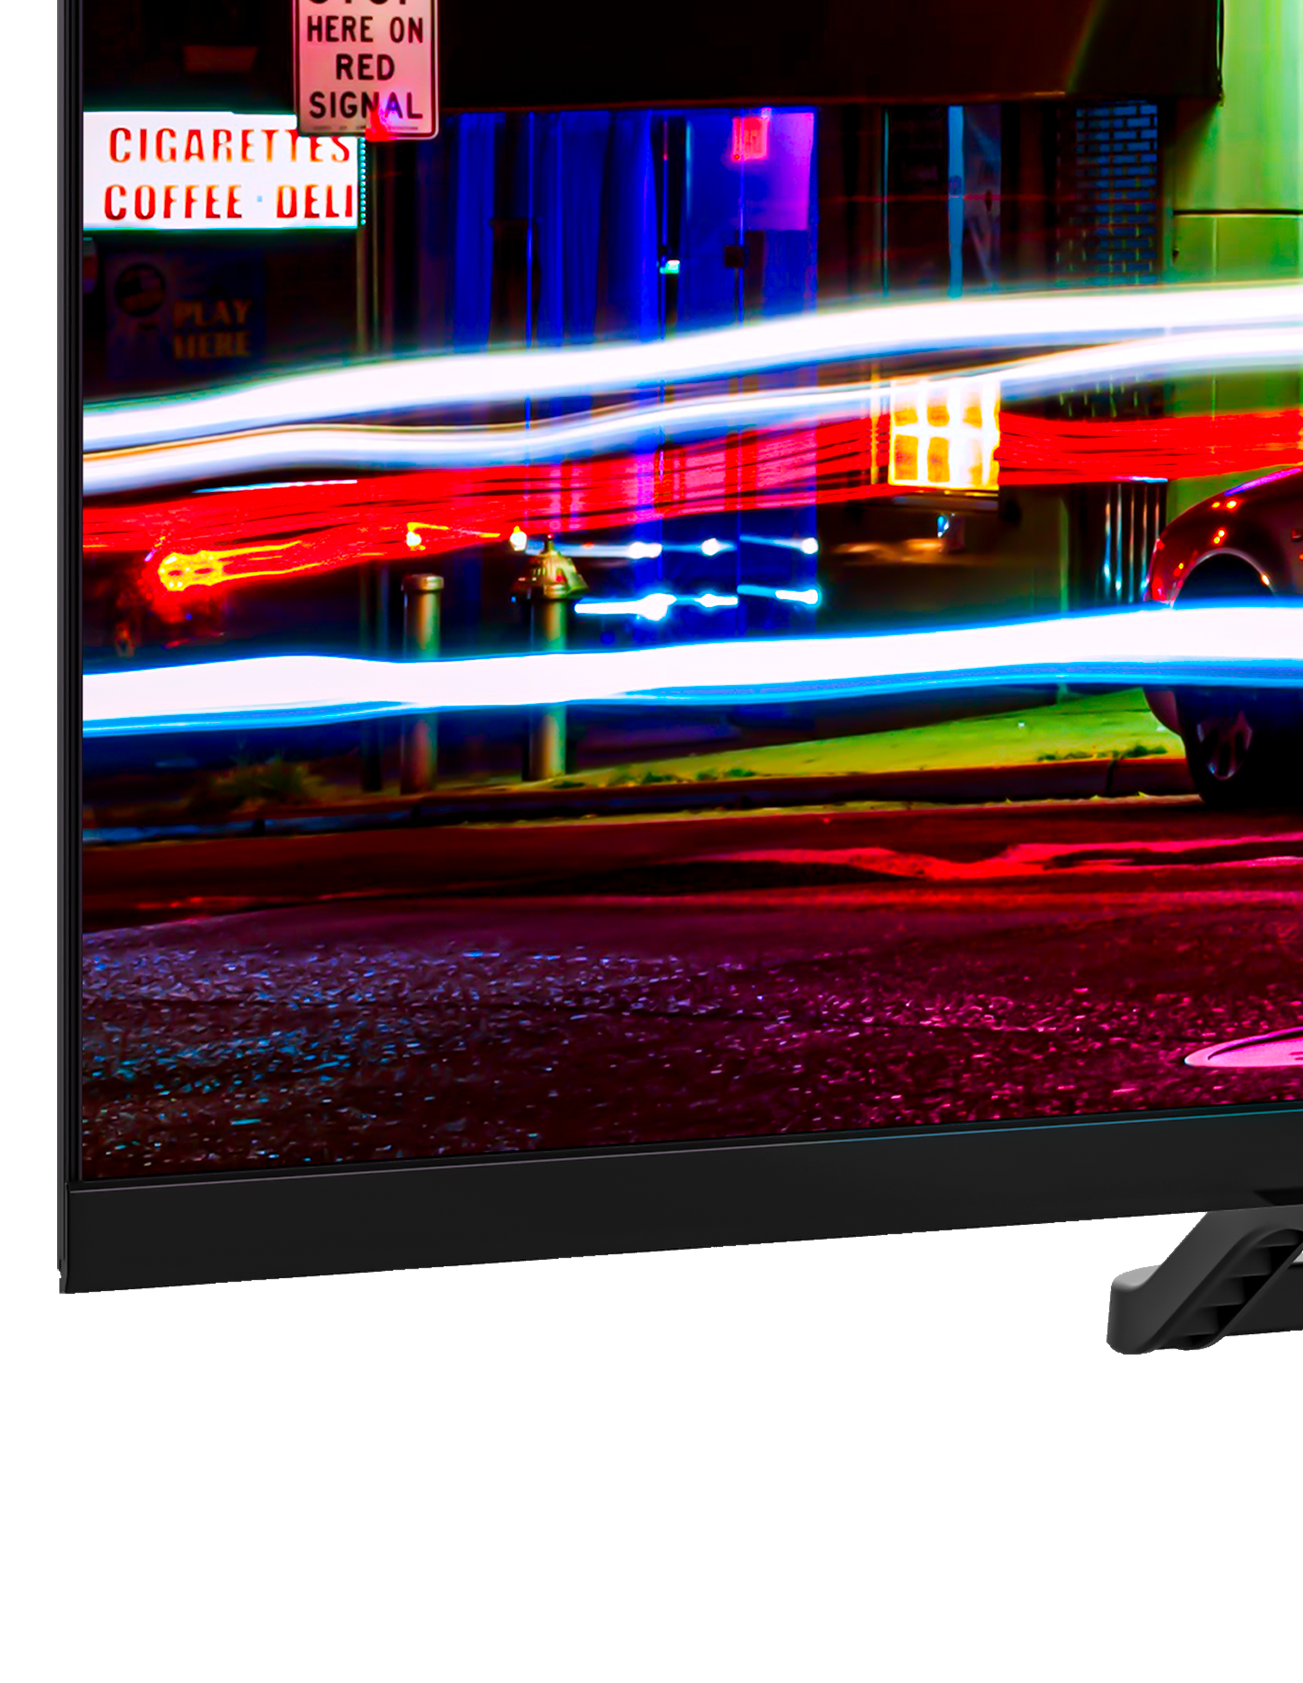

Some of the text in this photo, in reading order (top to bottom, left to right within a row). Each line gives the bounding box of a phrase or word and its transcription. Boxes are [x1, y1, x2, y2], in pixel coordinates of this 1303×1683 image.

[307, 15, 424, 44] HERE ON
[335, 53, 396, 81] RED
[308, 91, 424, 120] SIGNAL
[108, 127, 350, 164] CIGARETTES
[103, 184, 353, 221] COFFEE DELI
[171, 297, 252, 329] PLAY
[171, 330, 252, 360] HERE
